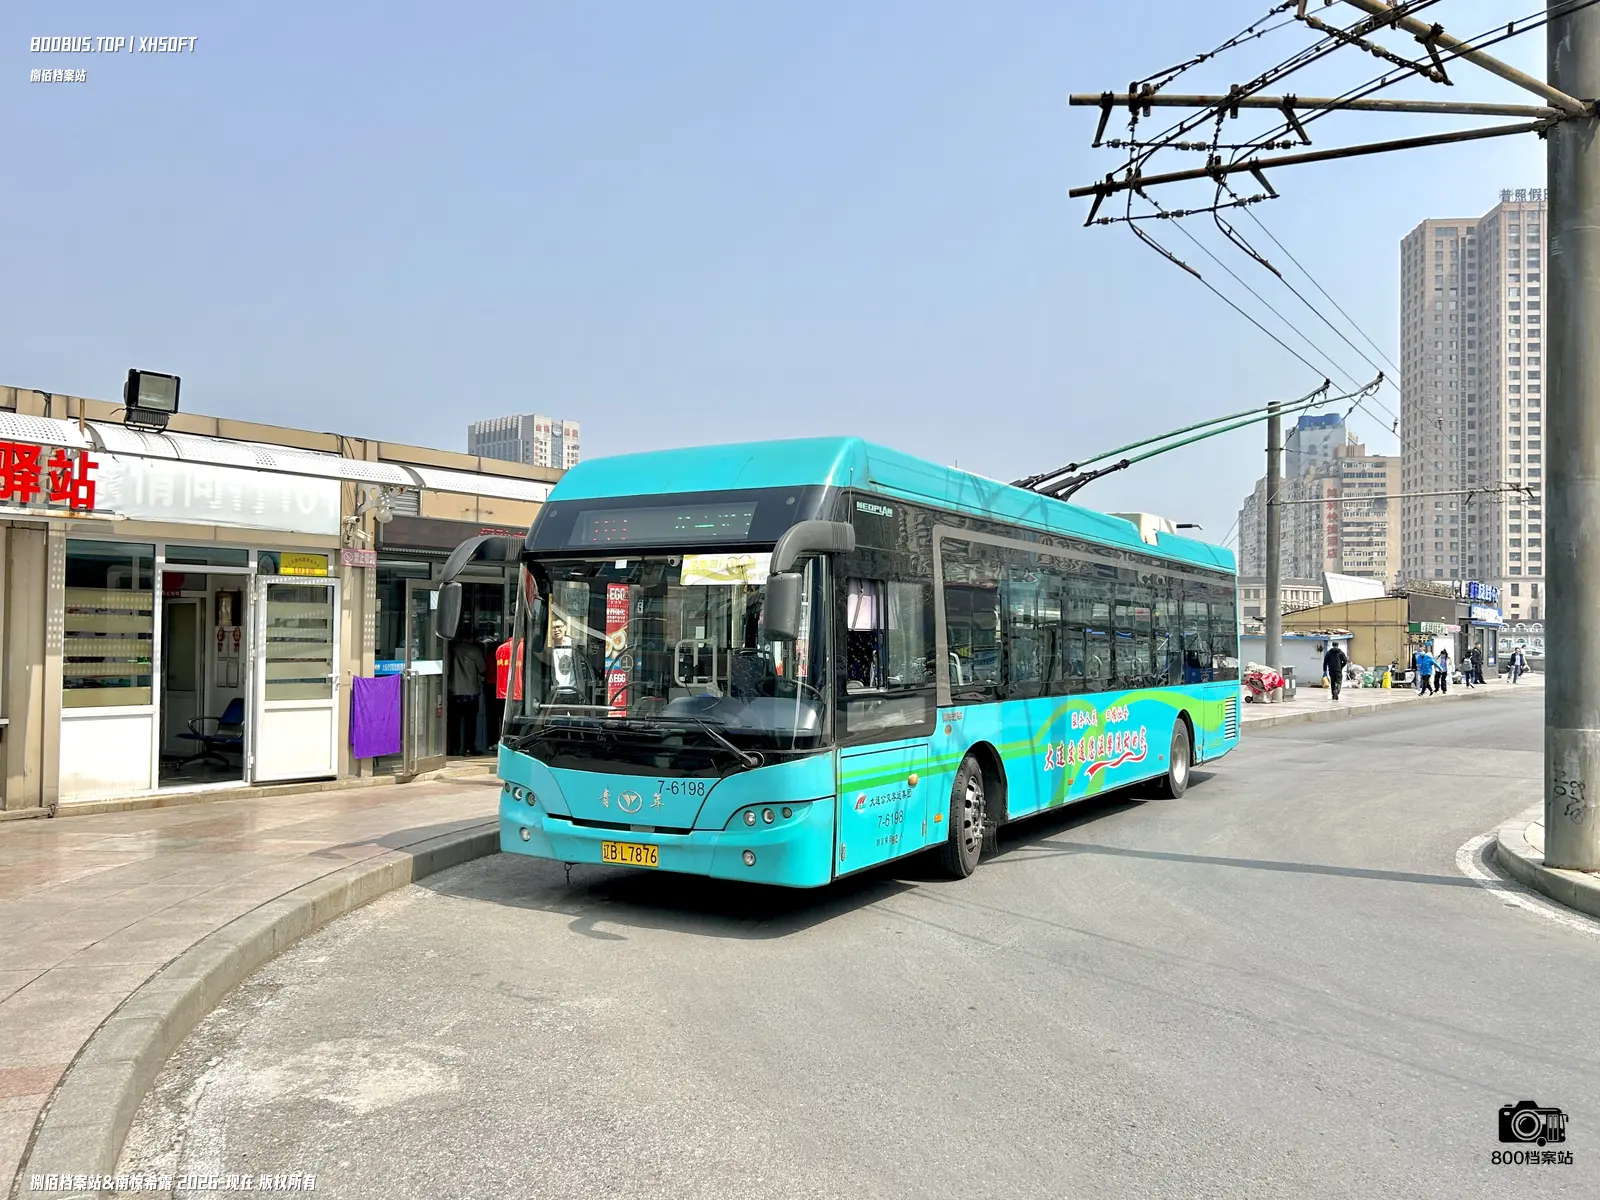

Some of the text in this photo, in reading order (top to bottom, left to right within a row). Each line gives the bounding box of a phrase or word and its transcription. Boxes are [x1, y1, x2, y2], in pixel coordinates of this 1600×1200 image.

[0, 440, 99, 510] 驿站
[856, 501, 893, 517] NEOPLAN
[657, 780, 705, 796] 7-6198
[878, 810, 904, 828] 7-6198
